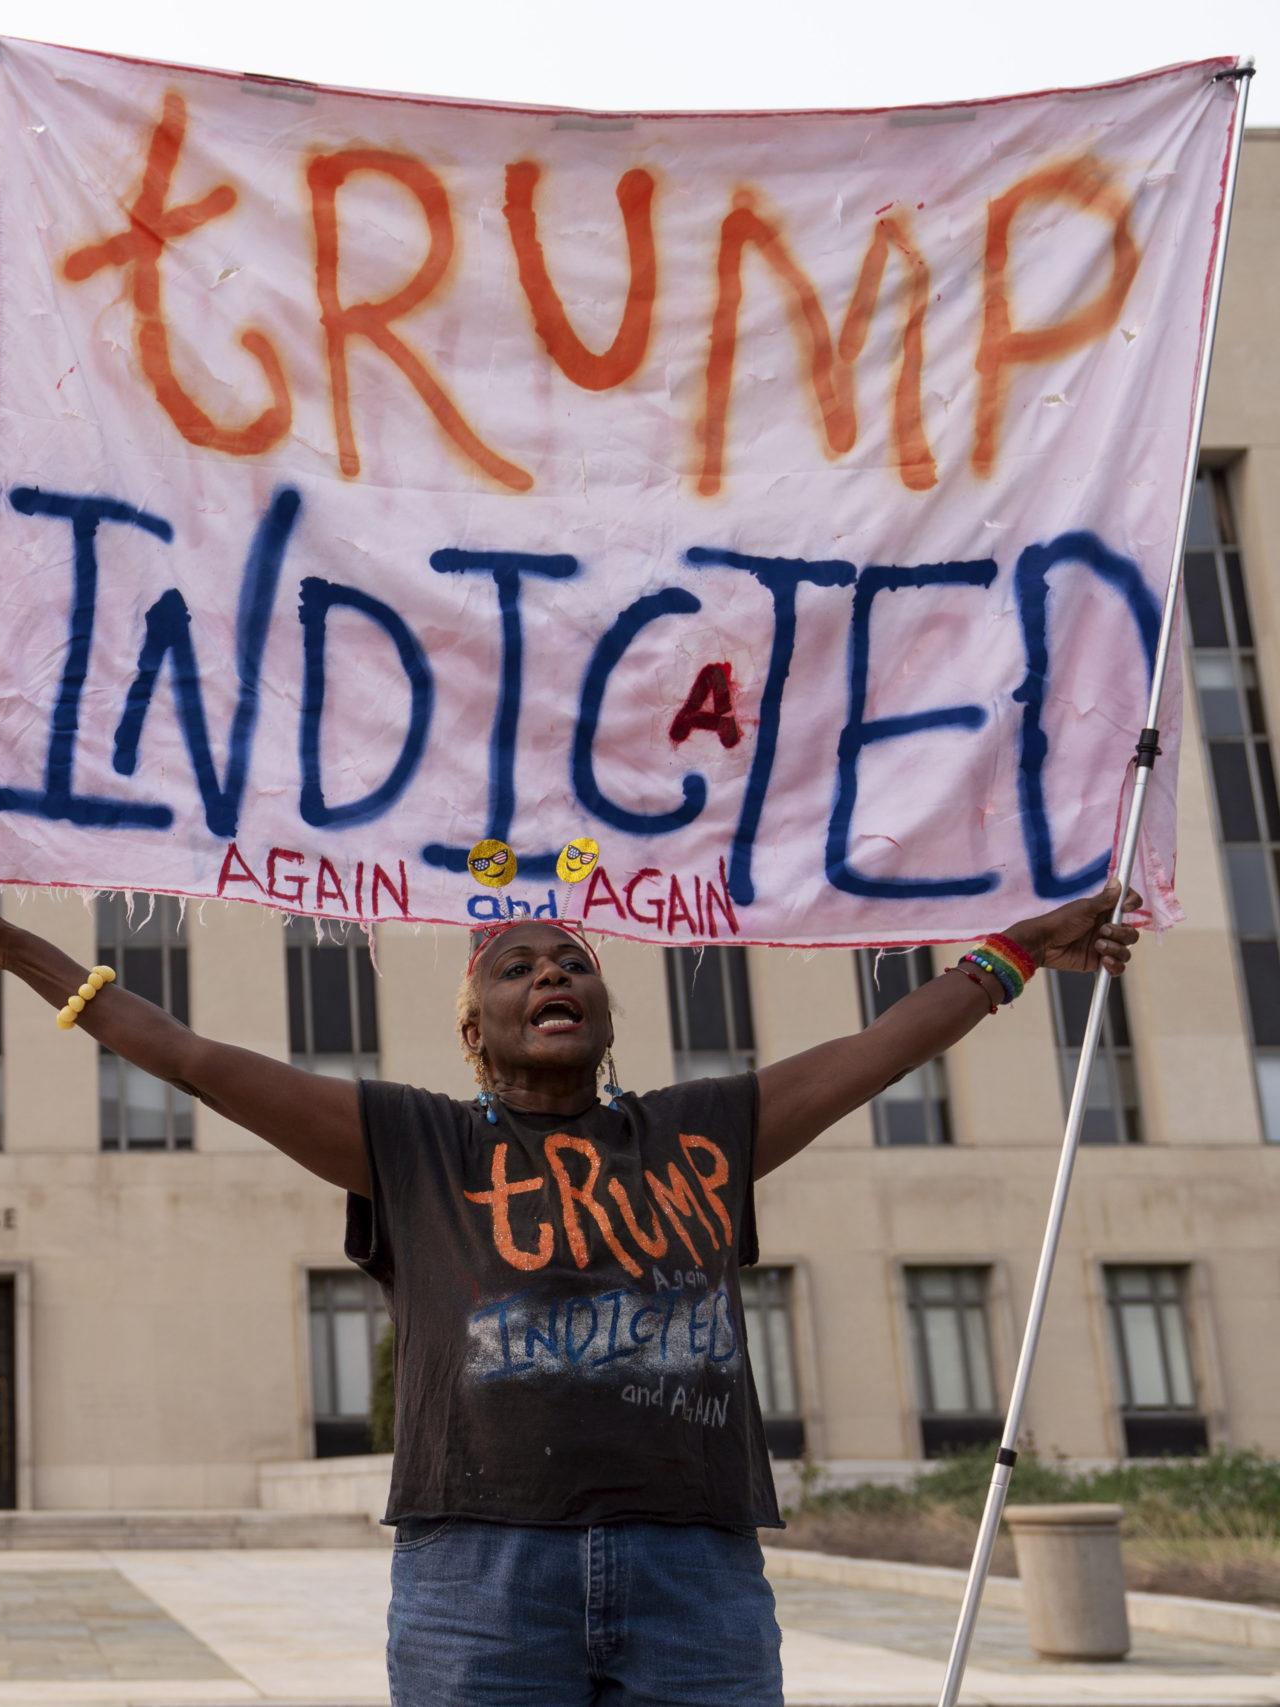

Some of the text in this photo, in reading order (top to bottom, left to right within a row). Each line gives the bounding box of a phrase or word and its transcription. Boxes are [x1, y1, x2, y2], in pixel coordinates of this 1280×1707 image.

[669, 661, 742, 750] A
[216, 841, 411, 917] AGAIN
[582, 855, 740, 938] AGAIN
[473, 1285, 737, 1383] INDICTED
[621, 1376, 730, 1428] and AGAIN
